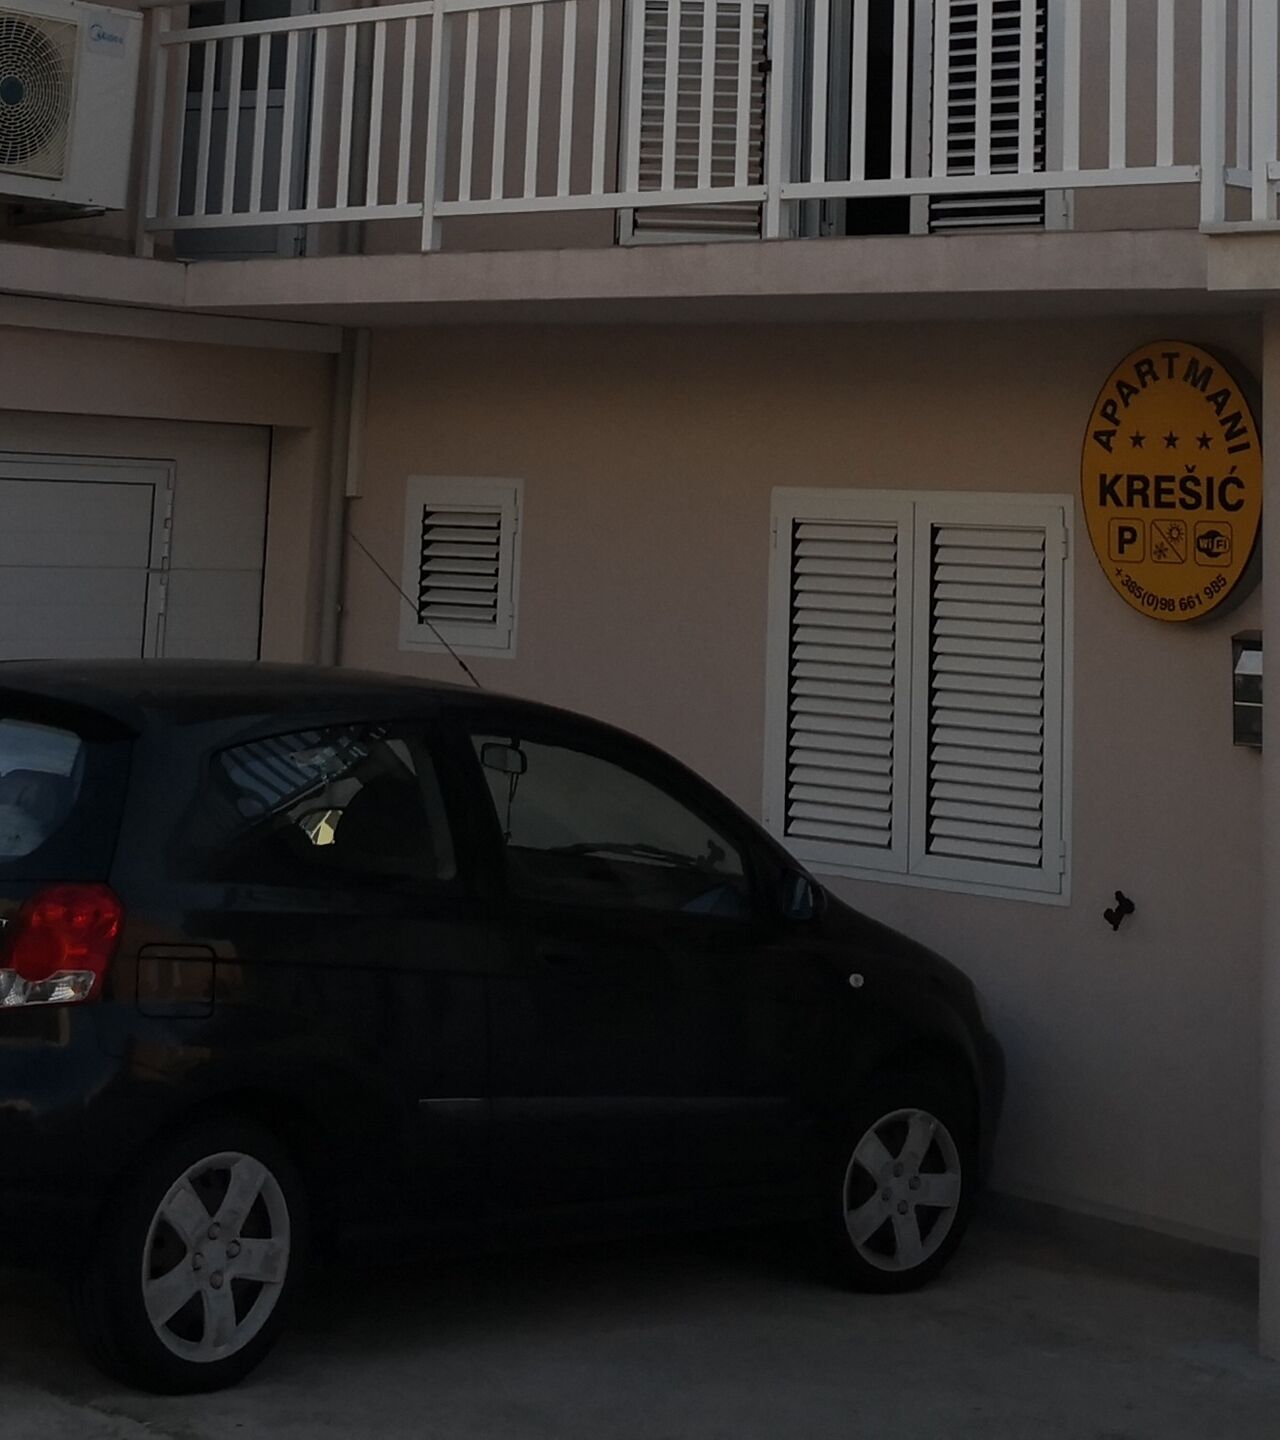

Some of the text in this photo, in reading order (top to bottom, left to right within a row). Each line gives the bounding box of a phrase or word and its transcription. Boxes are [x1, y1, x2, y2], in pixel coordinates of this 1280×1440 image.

[1093, 351, 1251, 454] APARTMANI
[1098, 464, 1246, 512] KREŠIĆ
[1179, 592, 1204, 612] 661
[1203, 573, 1228, 600] 985
